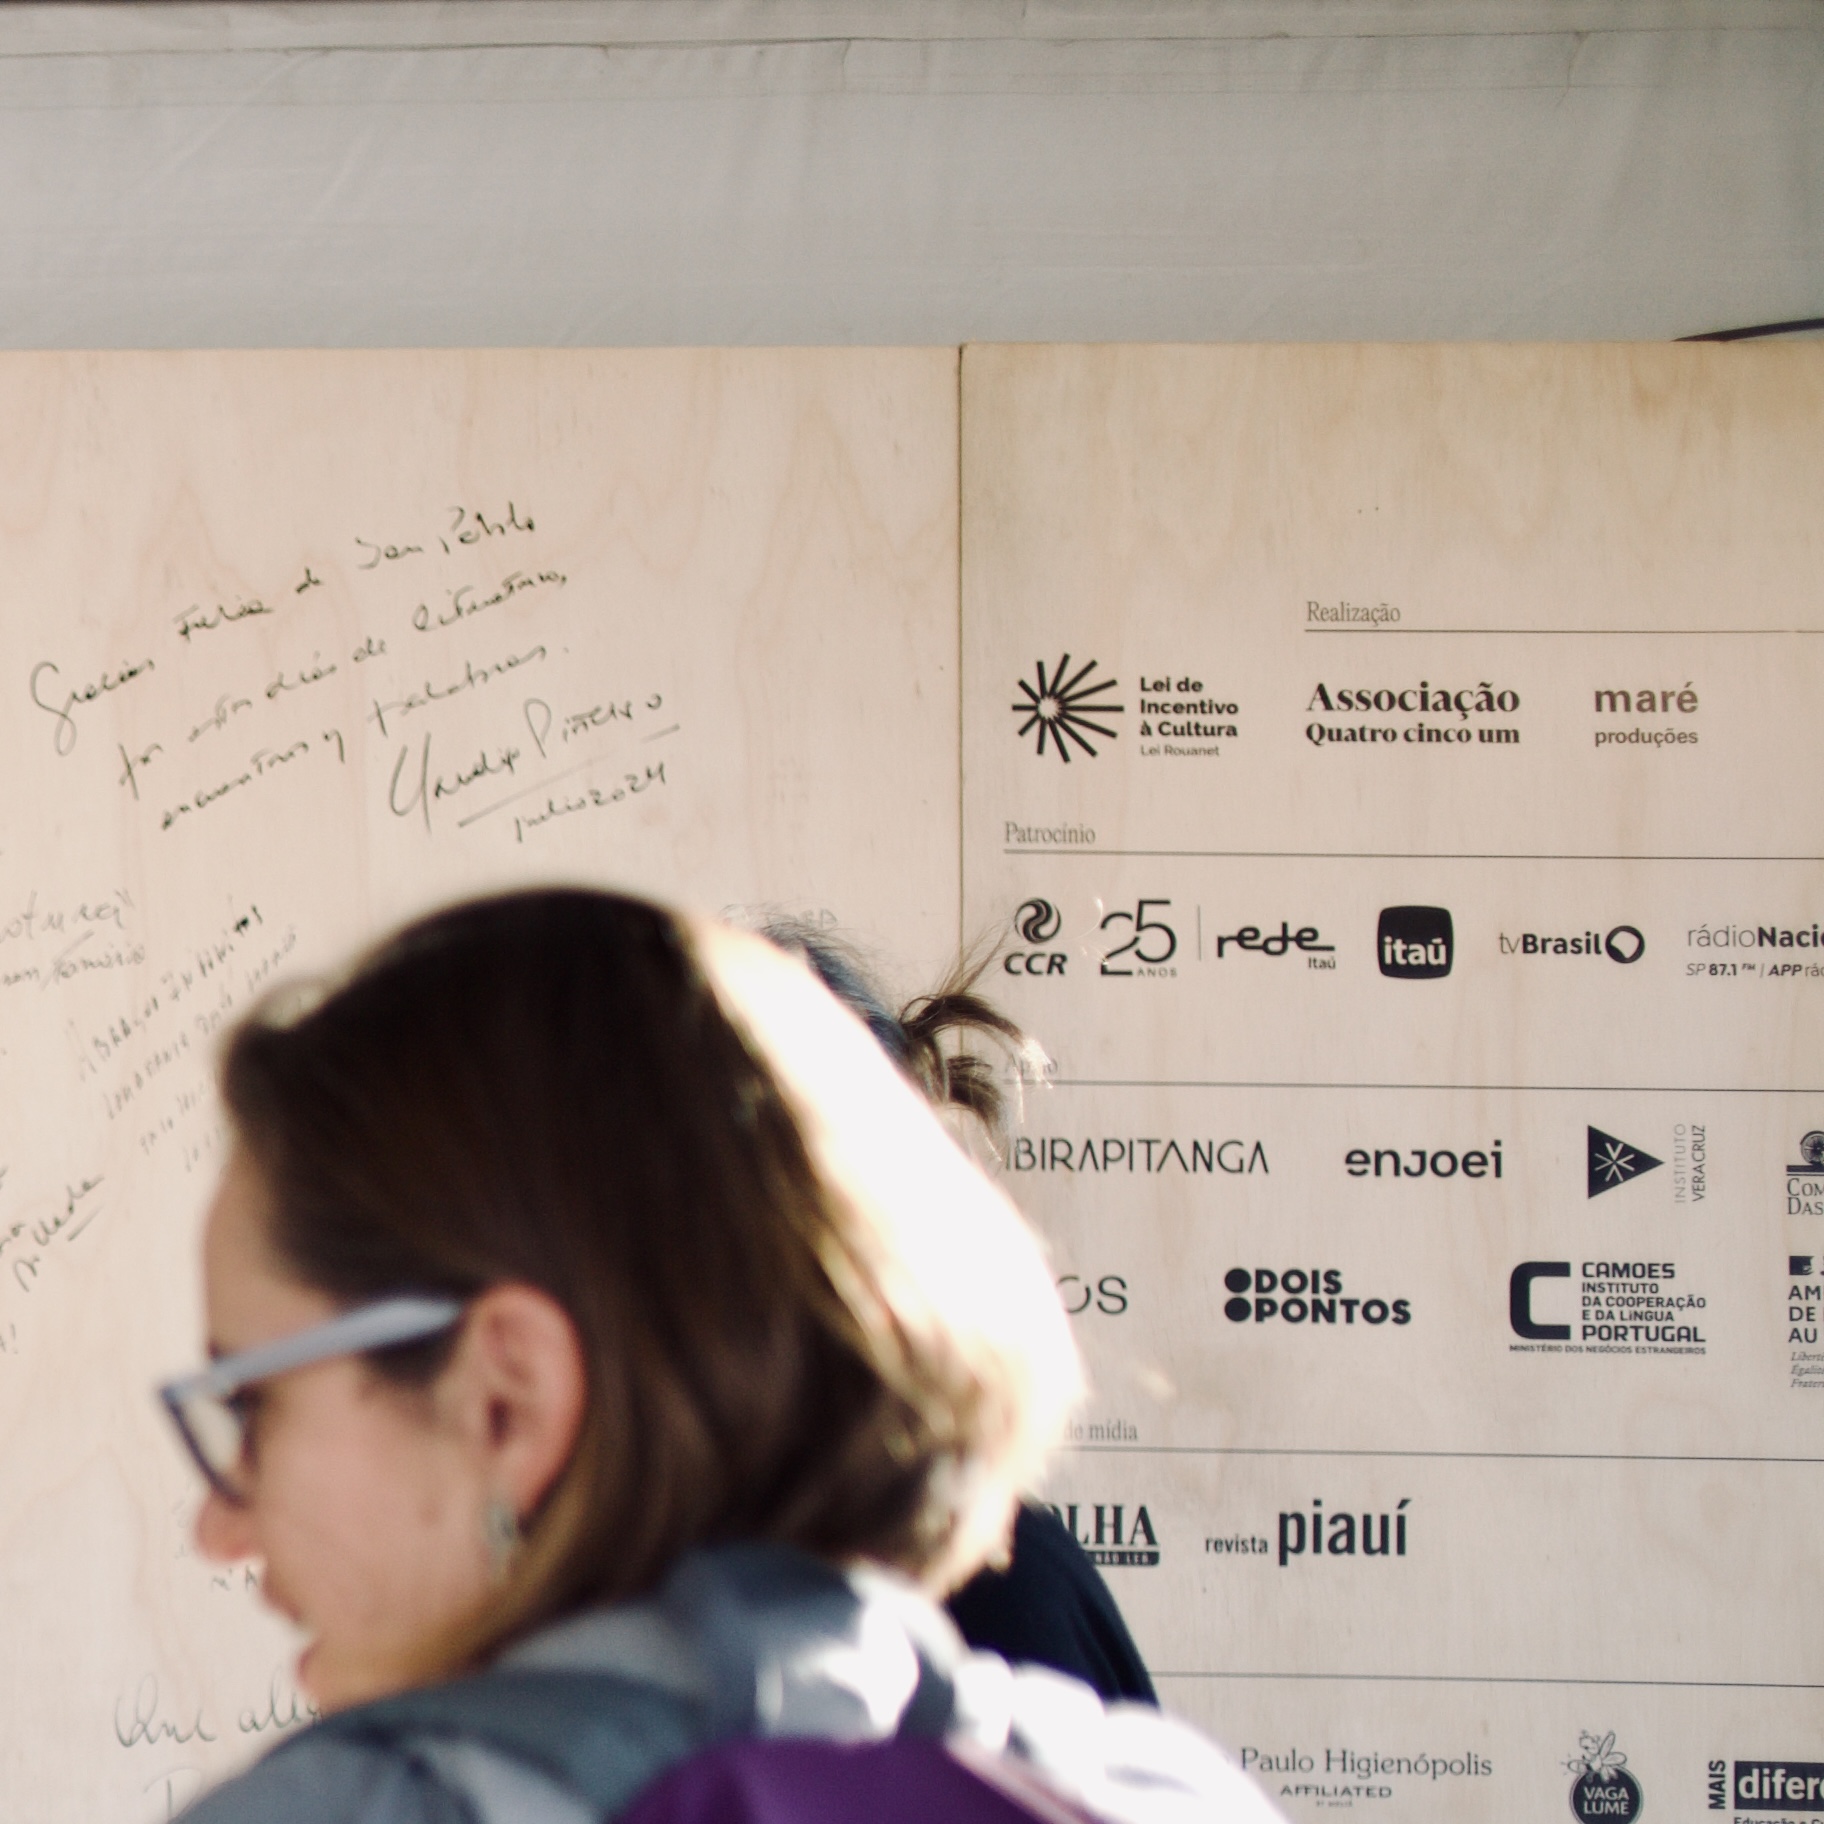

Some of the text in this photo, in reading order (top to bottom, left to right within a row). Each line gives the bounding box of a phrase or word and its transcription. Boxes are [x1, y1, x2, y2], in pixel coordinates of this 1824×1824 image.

[1306, 600, 1401, 627] Realização
[1139, 676, 1204, 692] Lei de
[1139, 698, 1240, 716] Incentivo
[1305, 680, 1521, 722] Associação
[1593, 681, 1699, 714] maré
[1139, 719, 1239, 738] à Cultura
[1304, 722, 1521, 747] Quatro cinco um
[1593, 727, 1699, 749] produções
[1140, 743, 1220, 757] Lei Rouanet
[1004, 820, 1097, 846] Patrocínio
[1099, 898, 1178, 977] 25
[1216, 921, 1336, 959] rede
[1499, 931, 1603, 956] tvBrasil
[1382, 934, 1447, 967] itaú
[1003, 952, 1068, 976] CCR
[1136, 967, 1178, 979] ANOS
[1307, 955, 1337, 970] Itaú
[1767, 963, 1803, 978] APP
[1344, 1139, 1504, 1179] enjoei
[1674, 1123, 1687, 1204] INSTITUTO
[1255, 1268, 1343, 1295] DOIS
[1581, 1282, 1659, 1294] INSTITUTO
[1255, 1296, 1412, 1325] PONTOS
[1581, 1294, 1707, 1312] DA COOPERAÇÃO
[1788, 1306, 1817, 1322] DE
[1581, 1309, 1615, 1321] E DA
[1581, 1325, 1707, 1343] PORTUGAL
[1788, 1327, 1818, 1343] AU
[1509, 1343, 1707, 1355] MINISTÉRIO DOS NEGÓCIOS ESTRANGEIROS
[1088, 1420, 1139, 1442] mídia
[1205, 1498, 1412, 1568] revista piauí
[1240, 1748, 1494, 1783] Paulo Higienópolis
[1583, 1785, 1630, 1801] VAGA
[1708, 1760, 1726, 1810] MAIS
[1583, 1800, 1630, 1816] LUME
